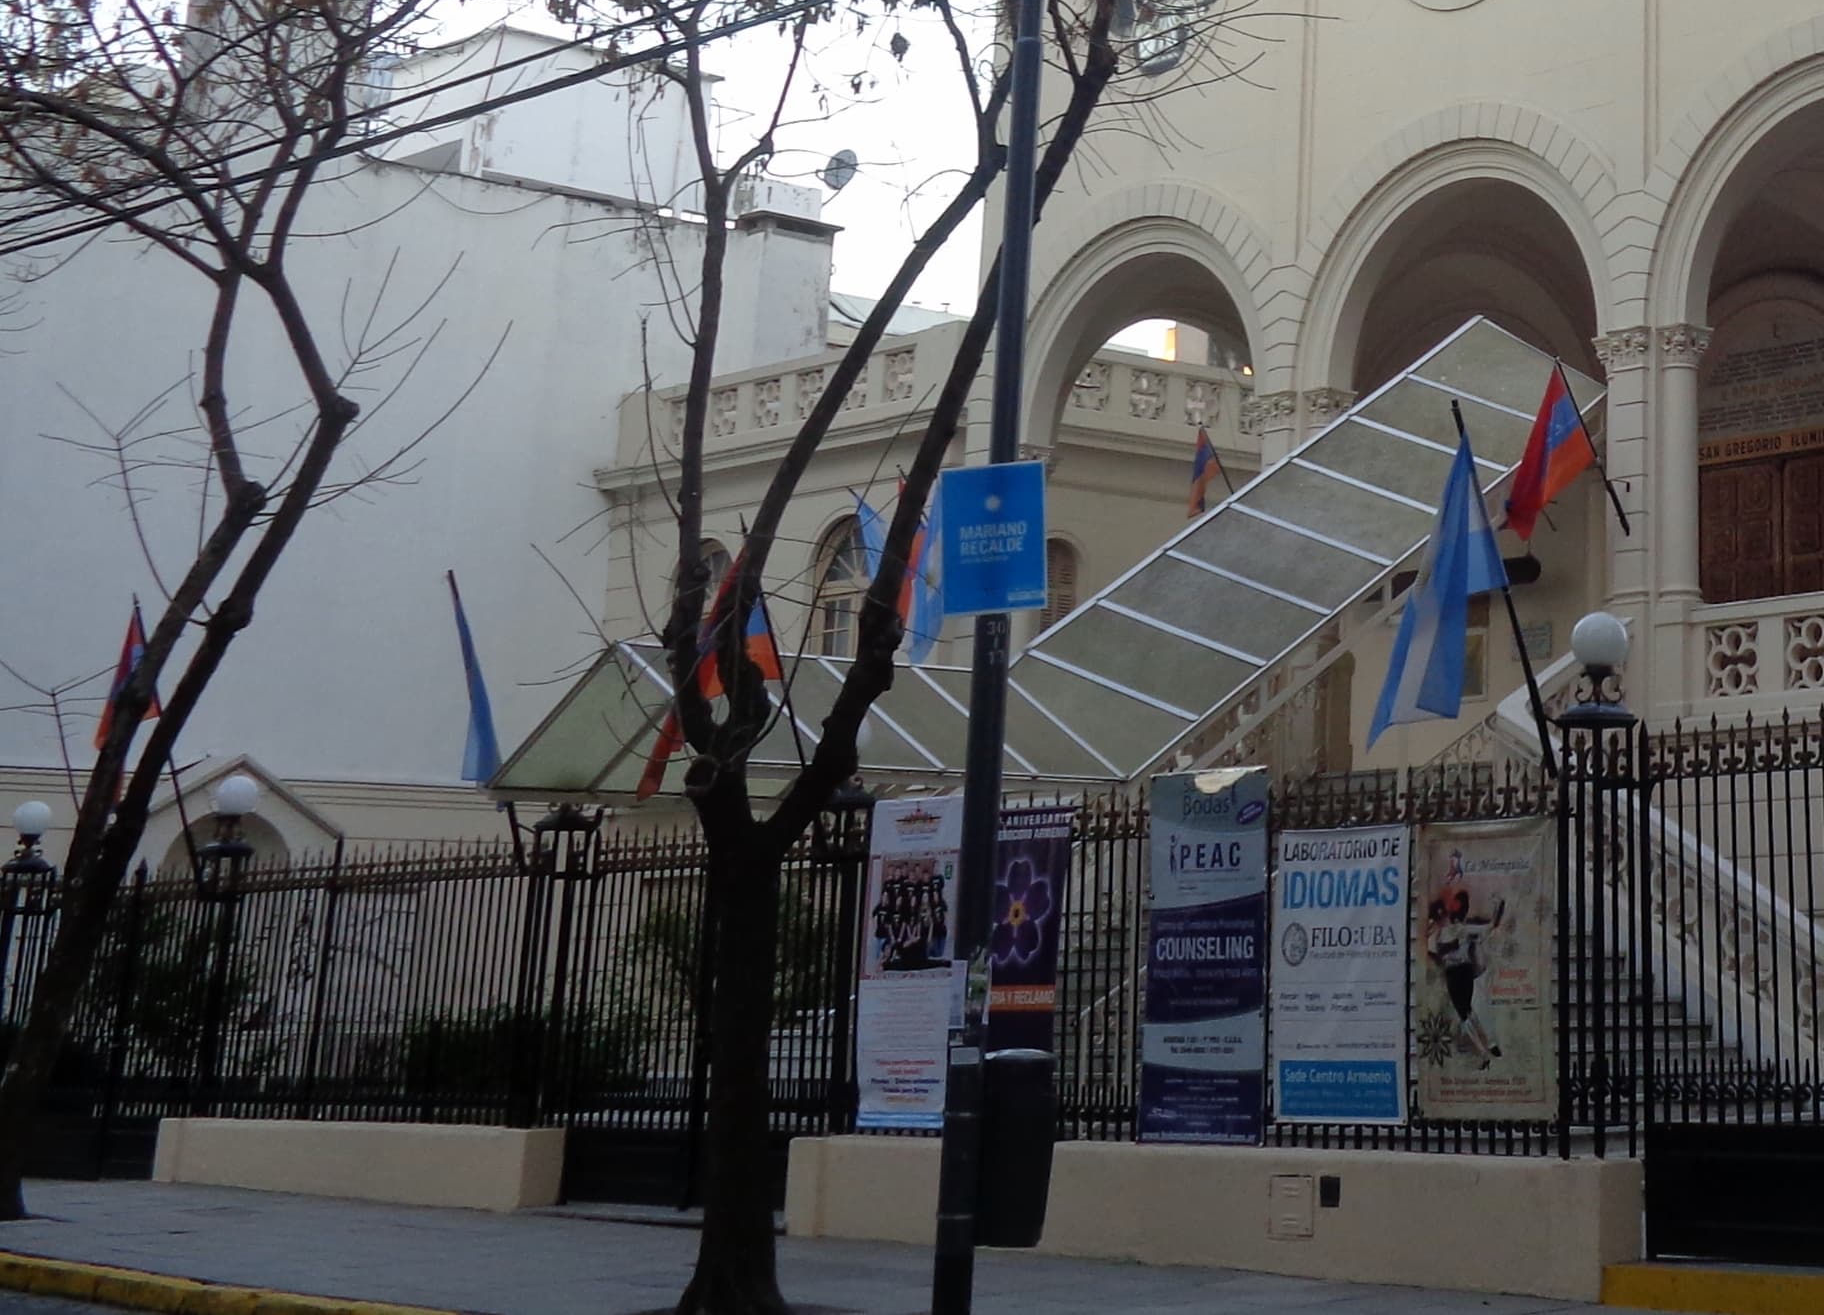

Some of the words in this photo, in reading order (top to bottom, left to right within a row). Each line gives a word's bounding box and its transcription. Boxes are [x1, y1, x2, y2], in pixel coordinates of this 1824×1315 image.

[1726, 436, 1781, 457] GREGORIO
[960, 522, 1027, 541] MARIANO
[961, 537, 1024, 557] RECALDE
[1284, 839, 1378, 862] LABORATORIO
[1382, 837, 1400, 857] DE
[1283, 866, 1400, 909] IDIOMAS
[1156, 935, 1255, 961] COUNSELING
[1284, 1068, 1307, 1084] Sede
[1310, 1068, 1345, 1084] Centro
[1347, 1069, 1392, 1084] Armenio
